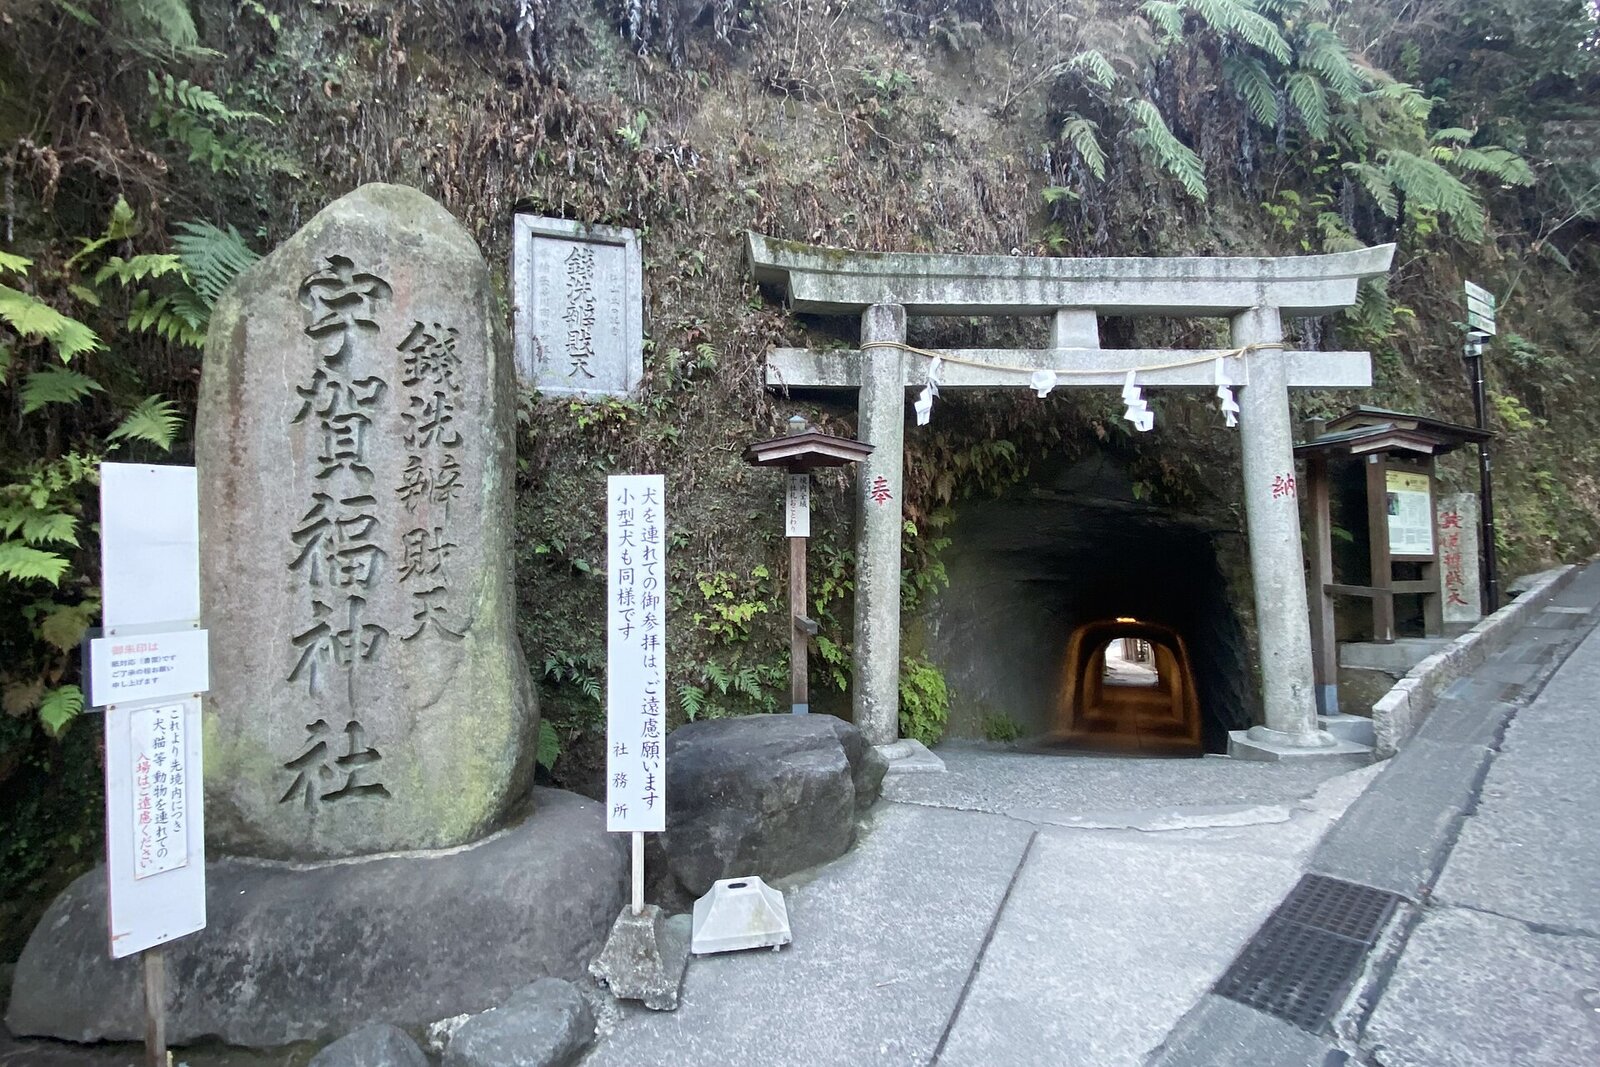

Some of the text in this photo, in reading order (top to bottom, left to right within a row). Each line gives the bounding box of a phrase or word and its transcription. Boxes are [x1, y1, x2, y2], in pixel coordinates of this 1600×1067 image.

[279, 254, 393, 814] 宇賀福神社
[870, 476, 893, 506] 奉
[1271, 473, 1295, 499] 納
[617, 487, 636, 641] 小型犬も同様です
[111, 642, 159, 655] 御朱印は
[111, 677, 159, 688] 申し上げます
[641, 487, 660, 811] 犬を連れての御参拝は、ご遠慮願います
[135, 752, 152, 869] 入場はご遠慮ください
[169, 709, 184, 833] これより先境内につき
[612, 741, 629, 820] 社務所
